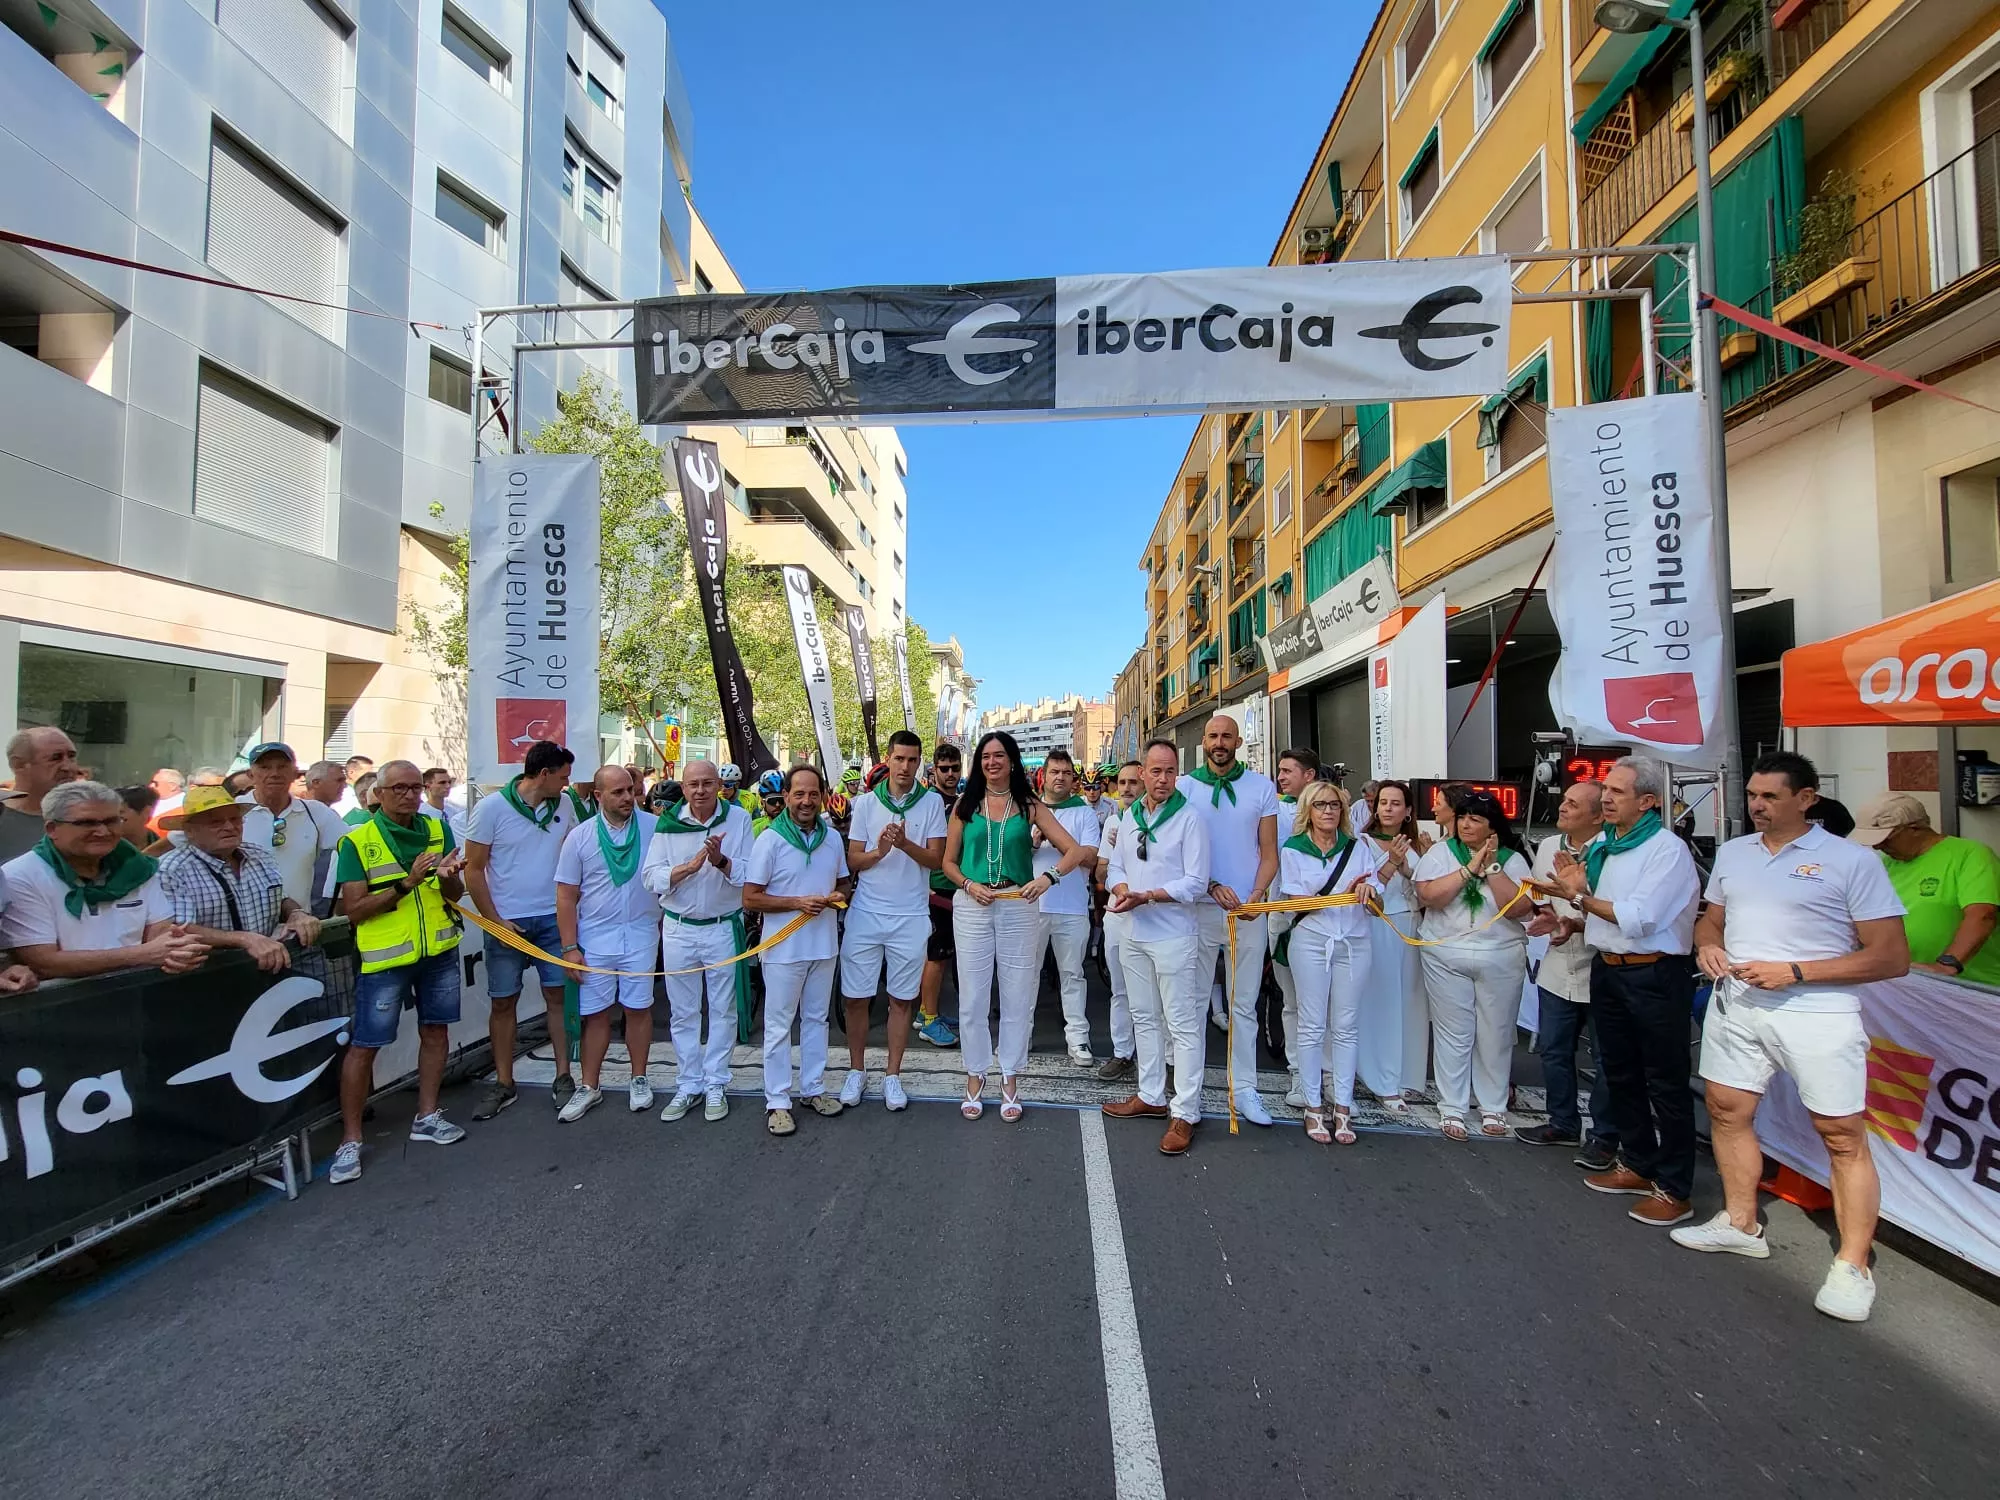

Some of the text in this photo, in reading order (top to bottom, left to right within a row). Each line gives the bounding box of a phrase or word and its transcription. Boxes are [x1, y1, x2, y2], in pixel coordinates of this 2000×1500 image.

[652, 317, 886, 379] iberCaja
[1077, 302, 1334, 363] iberCaja
[496, 471, 535, 688] Ayuntamiento
[1590, 422, 1649, 665] Ayuntamiento
[1649, 471, 1690, 662] de Huesca
[537, 523, 567, 690] de Huesca
[1316, 599, 1354, 632] iberCaja
[801, 611, 826, 683] iberCaja
[1272, 632, 1300, 658] iberCaja
[1860, 648, 2000, 714] ara
[0, 1067, 133, 1180] ja
